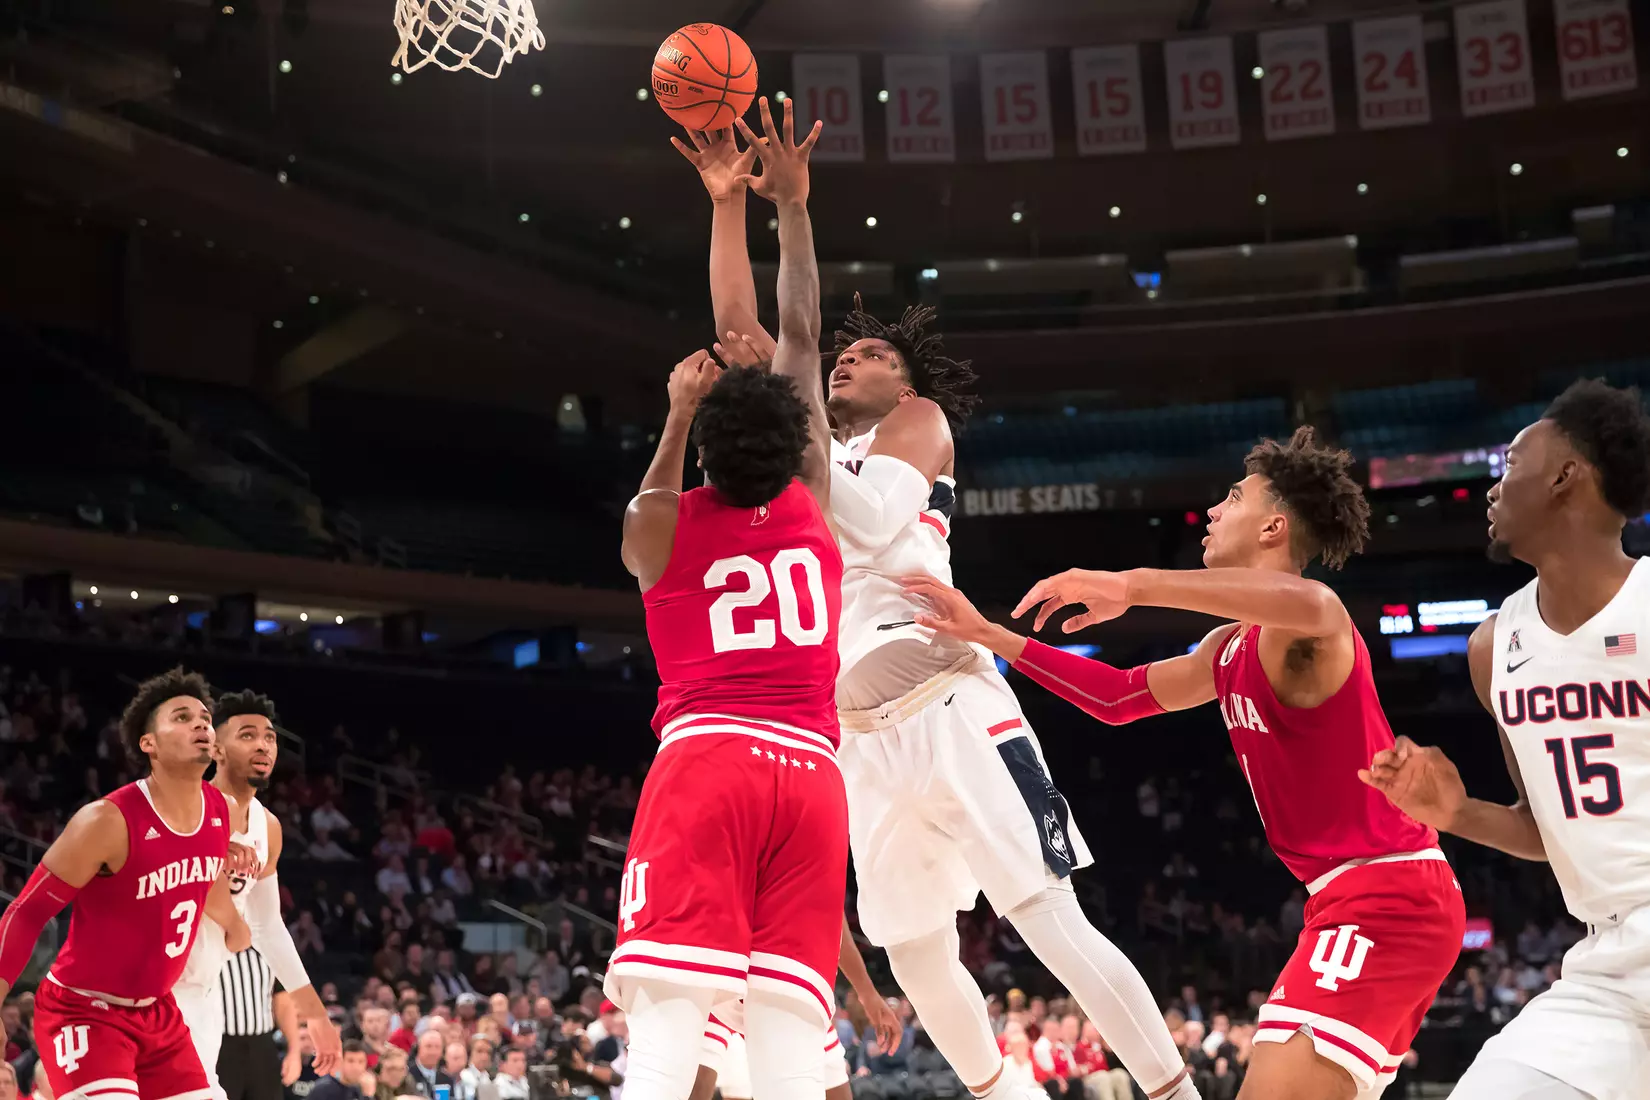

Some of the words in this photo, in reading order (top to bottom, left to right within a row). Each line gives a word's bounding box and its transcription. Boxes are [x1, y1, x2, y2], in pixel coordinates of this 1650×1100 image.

[1464, 32, 1524, 78] 33
[1561, 12, 1629, 61] 613
[1180, 69, 1225, 112] 19
[1268, 59, 1325, 104] 22
[1362, 49, 1419, 92] 24
[806, 86, 850, 126] 10
[898, 86, 942, 126] 12
[995, 83, 1038, 126] 15
[1087, 77, 1132, 118] 15
[963, 489, 1024, 516] BLUE
[1029, 484, 1100, 513] SEATS
[703, 547, 829, 654] 20
[1499, 679, 1650, 726] UCONN
[1544, 733, 1625, 819] 15
[165, 899, 198, 959] 3
